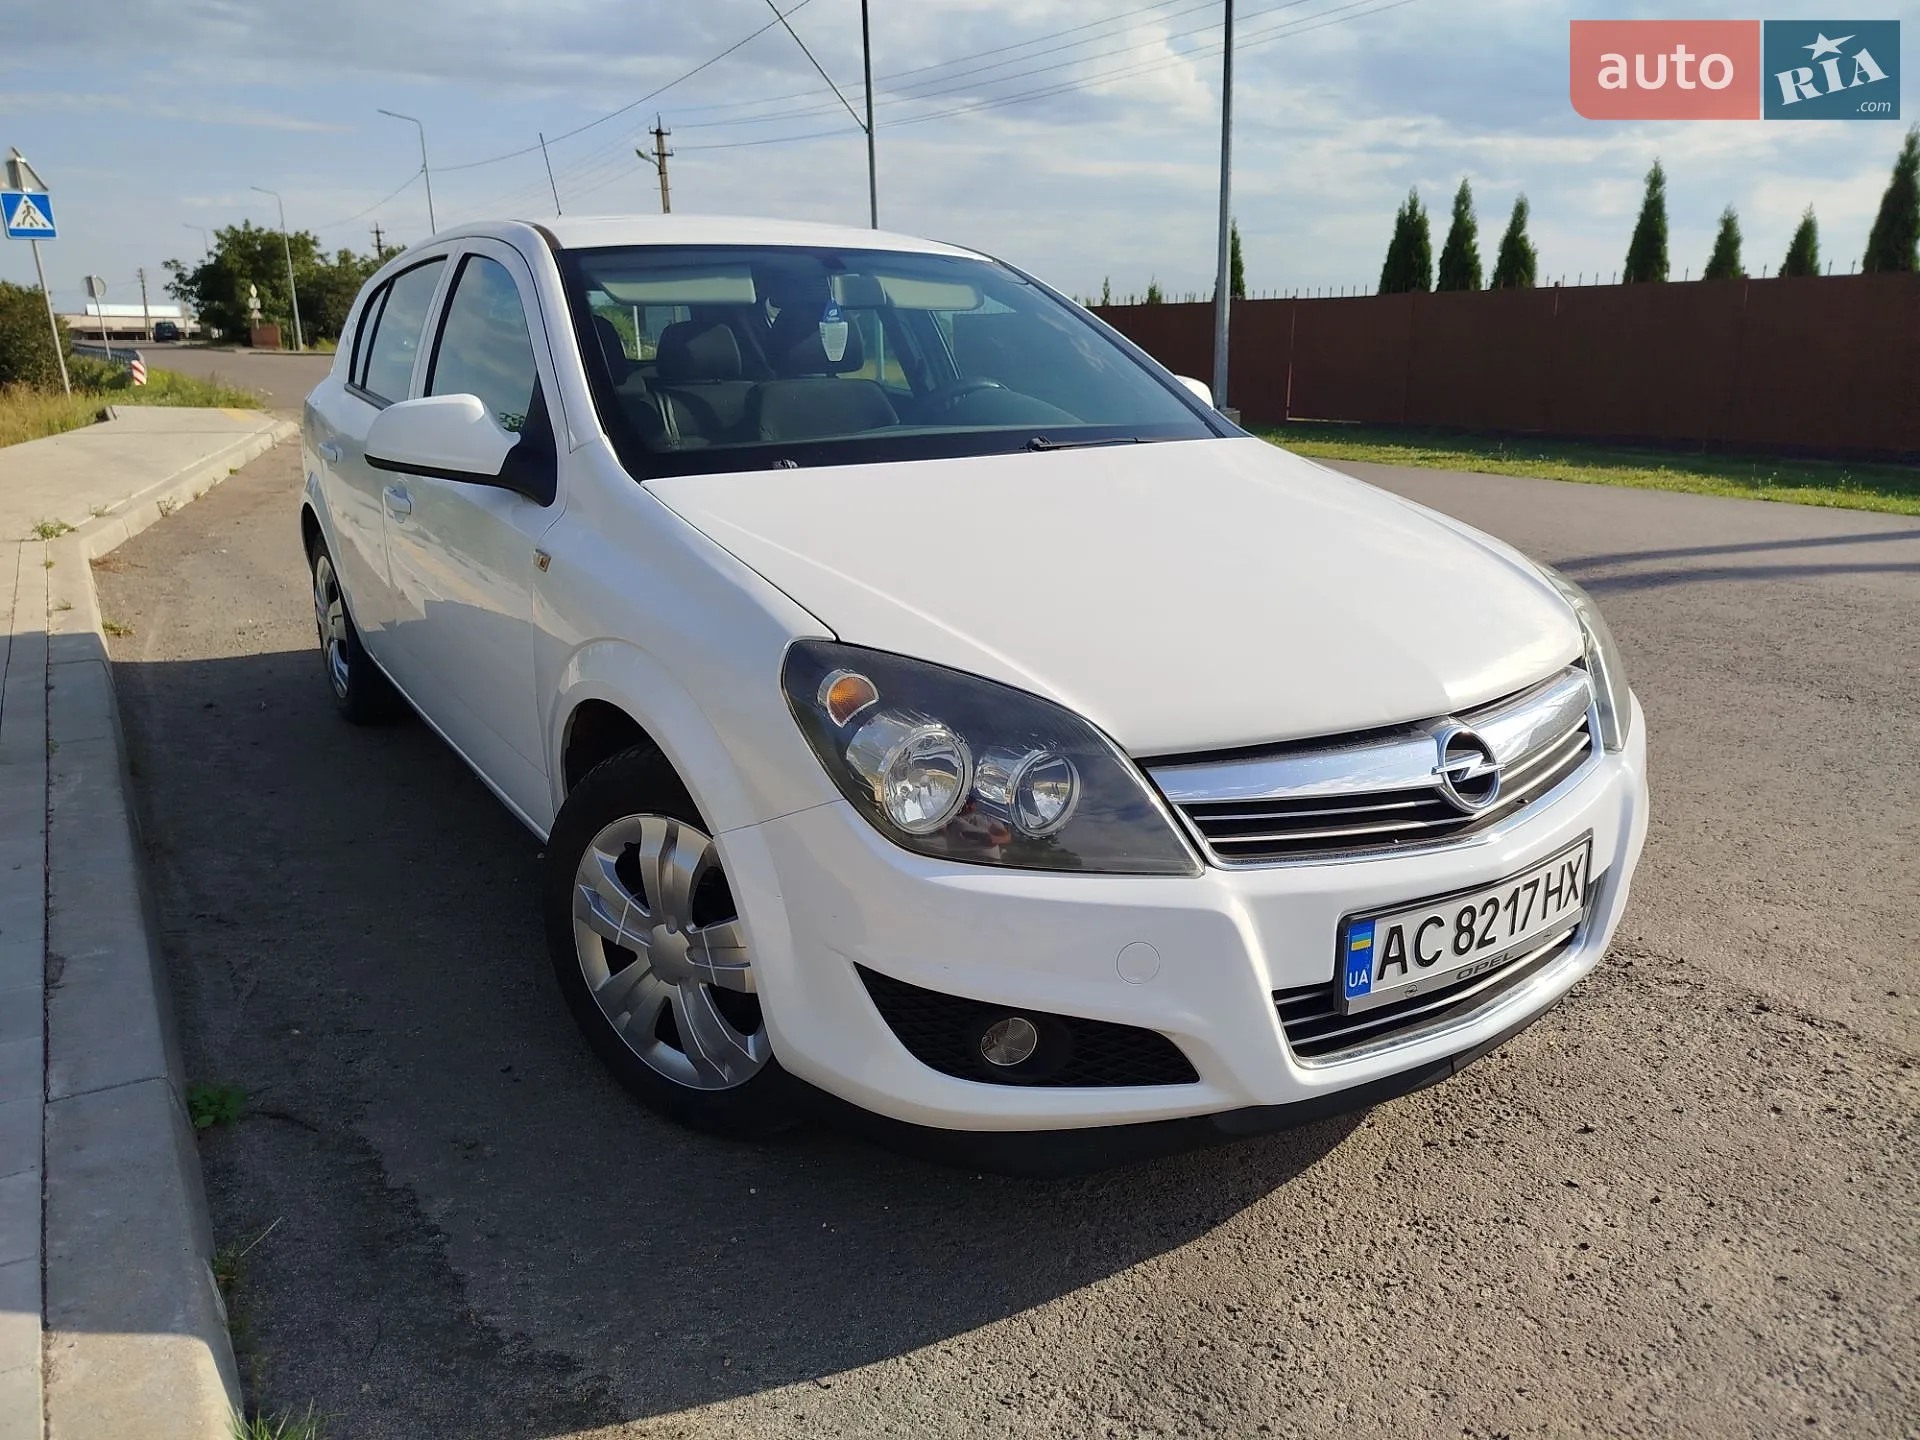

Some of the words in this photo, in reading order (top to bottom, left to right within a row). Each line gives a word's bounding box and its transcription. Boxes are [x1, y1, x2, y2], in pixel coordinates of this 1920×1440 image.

[1377, 915, 1446, 981] AC
[1452, 877, 1541, 956] 8217
[1541, 854, 1584, 920] HX
[1348, 969, 1369, 988] UA
[1456, 952, 1514, 981] OPEL
